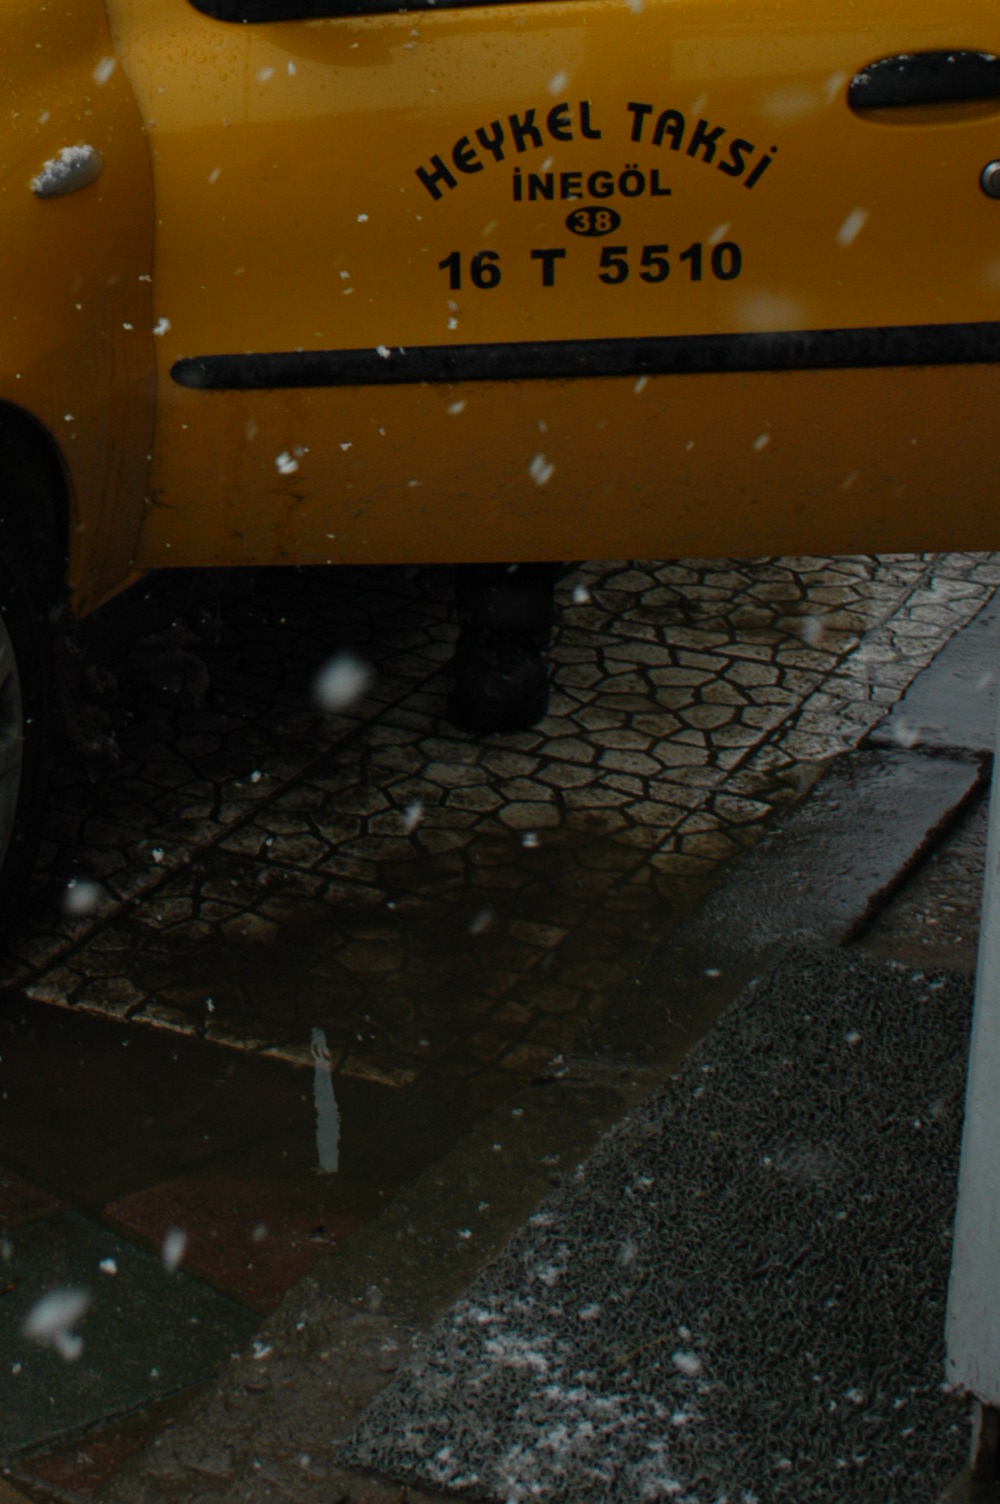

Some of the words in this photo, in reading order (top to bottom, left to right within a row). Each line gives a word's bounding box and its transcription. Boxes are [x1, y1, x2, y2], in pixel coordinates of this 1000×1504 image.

[415, 100, 602, 201] HEYKEL
[627, 101, 778, 190] TAKSİ
[512, 163, 672, 201] İNEGÖL
[573, 210, 613, 233] 38
[438, 250, 502, 290] 16
[531, 248, 566, 287] T
[599, 241, 742, 284] 5510
